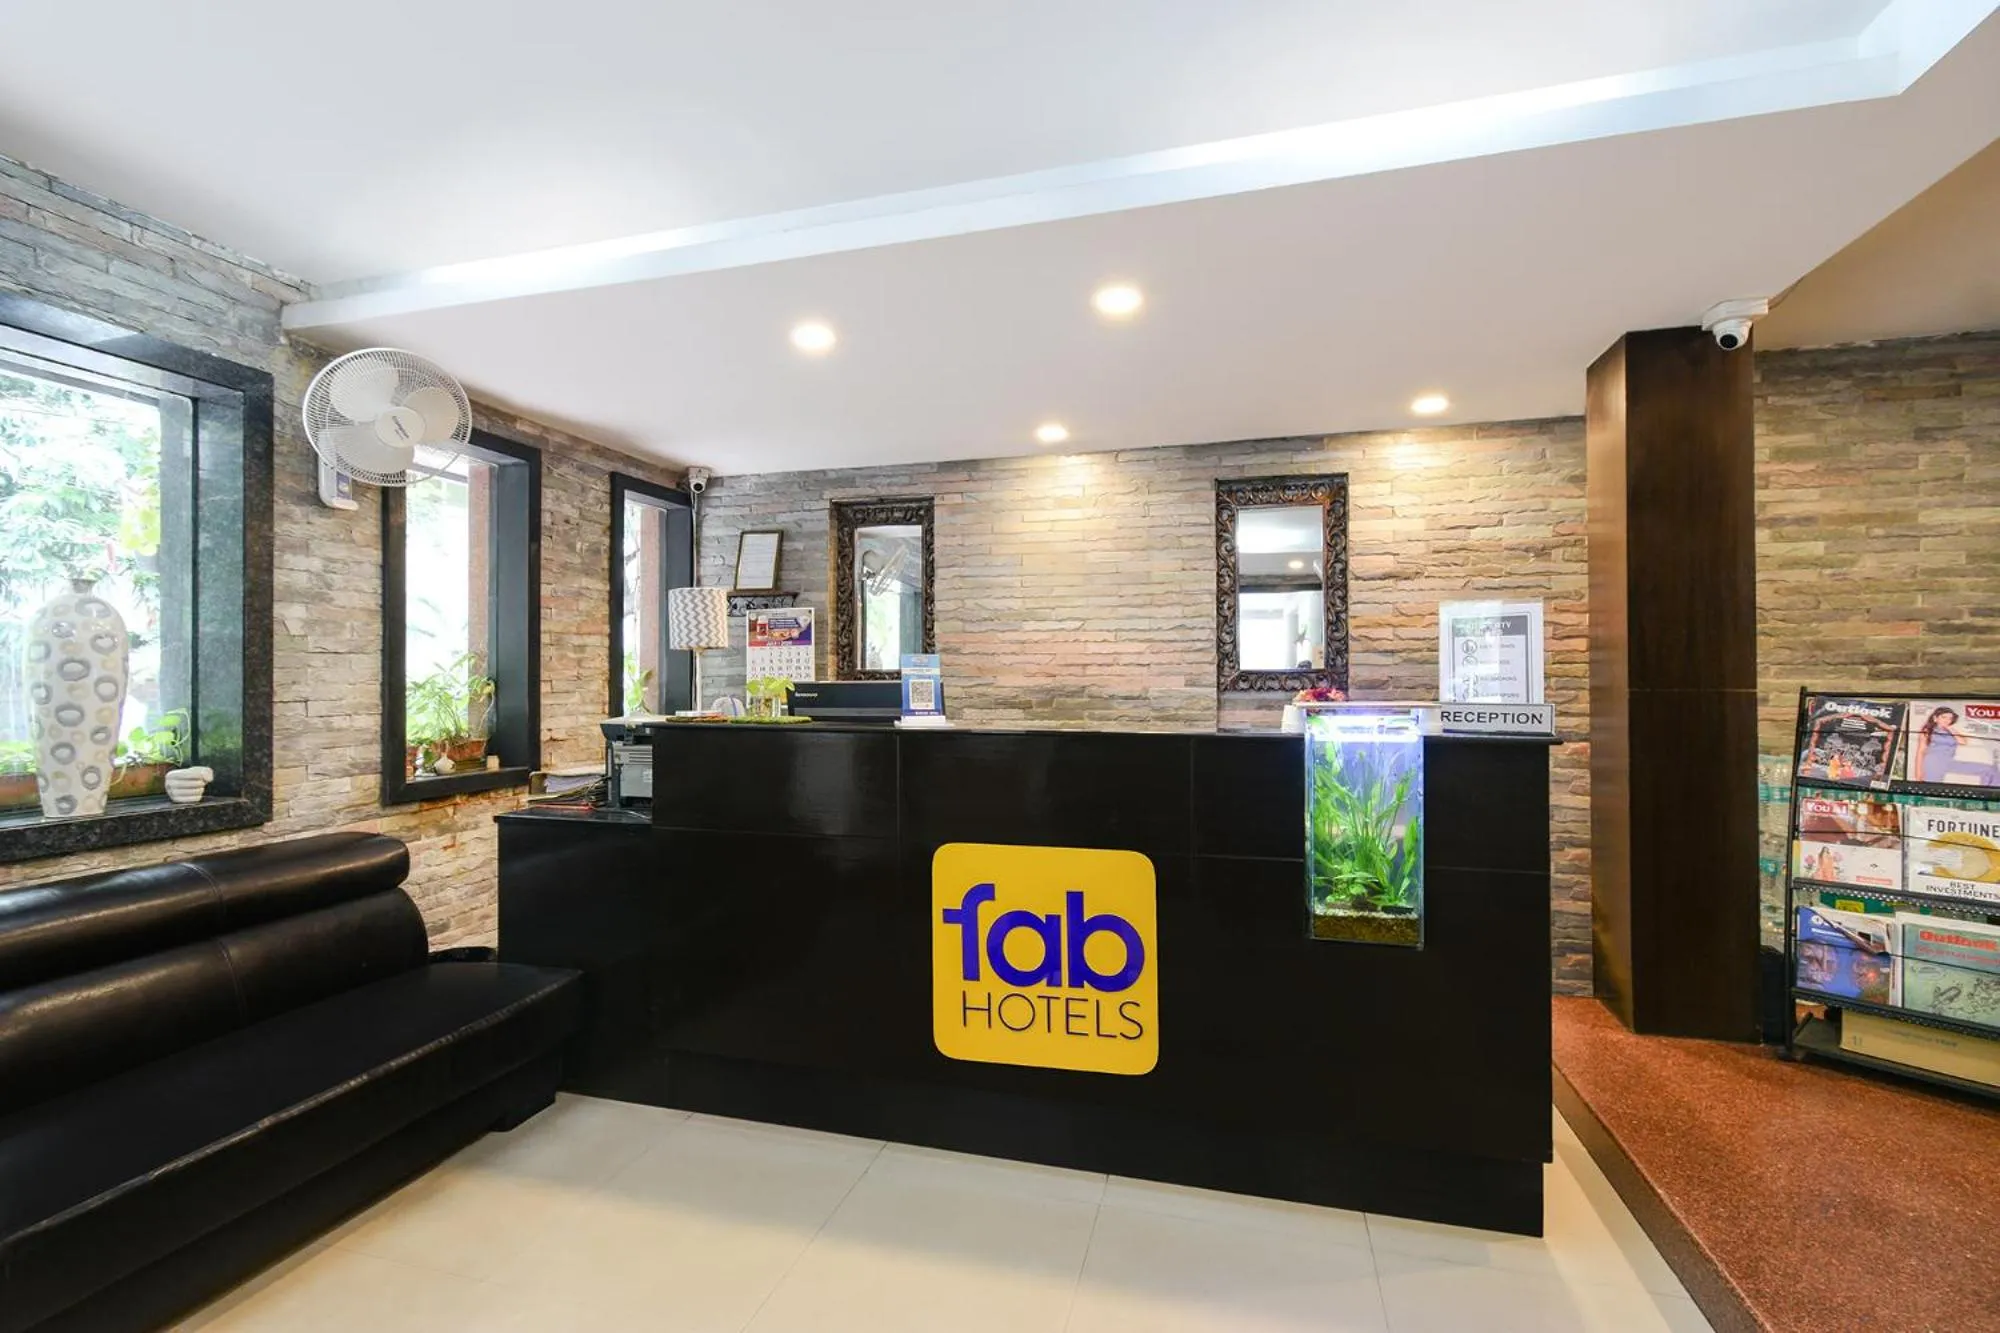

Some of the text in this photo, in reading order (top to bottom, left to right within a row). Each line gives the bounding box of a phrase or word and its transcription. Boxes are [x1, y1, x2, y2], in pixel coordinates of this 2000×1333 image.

[1440, 710, 1544, 725] RECEPTION
[1824, 701, 1893, 719] Outlook
[942, 883, 1145, 993] fab
[962, 990, 1144, 1041] HOTELS
